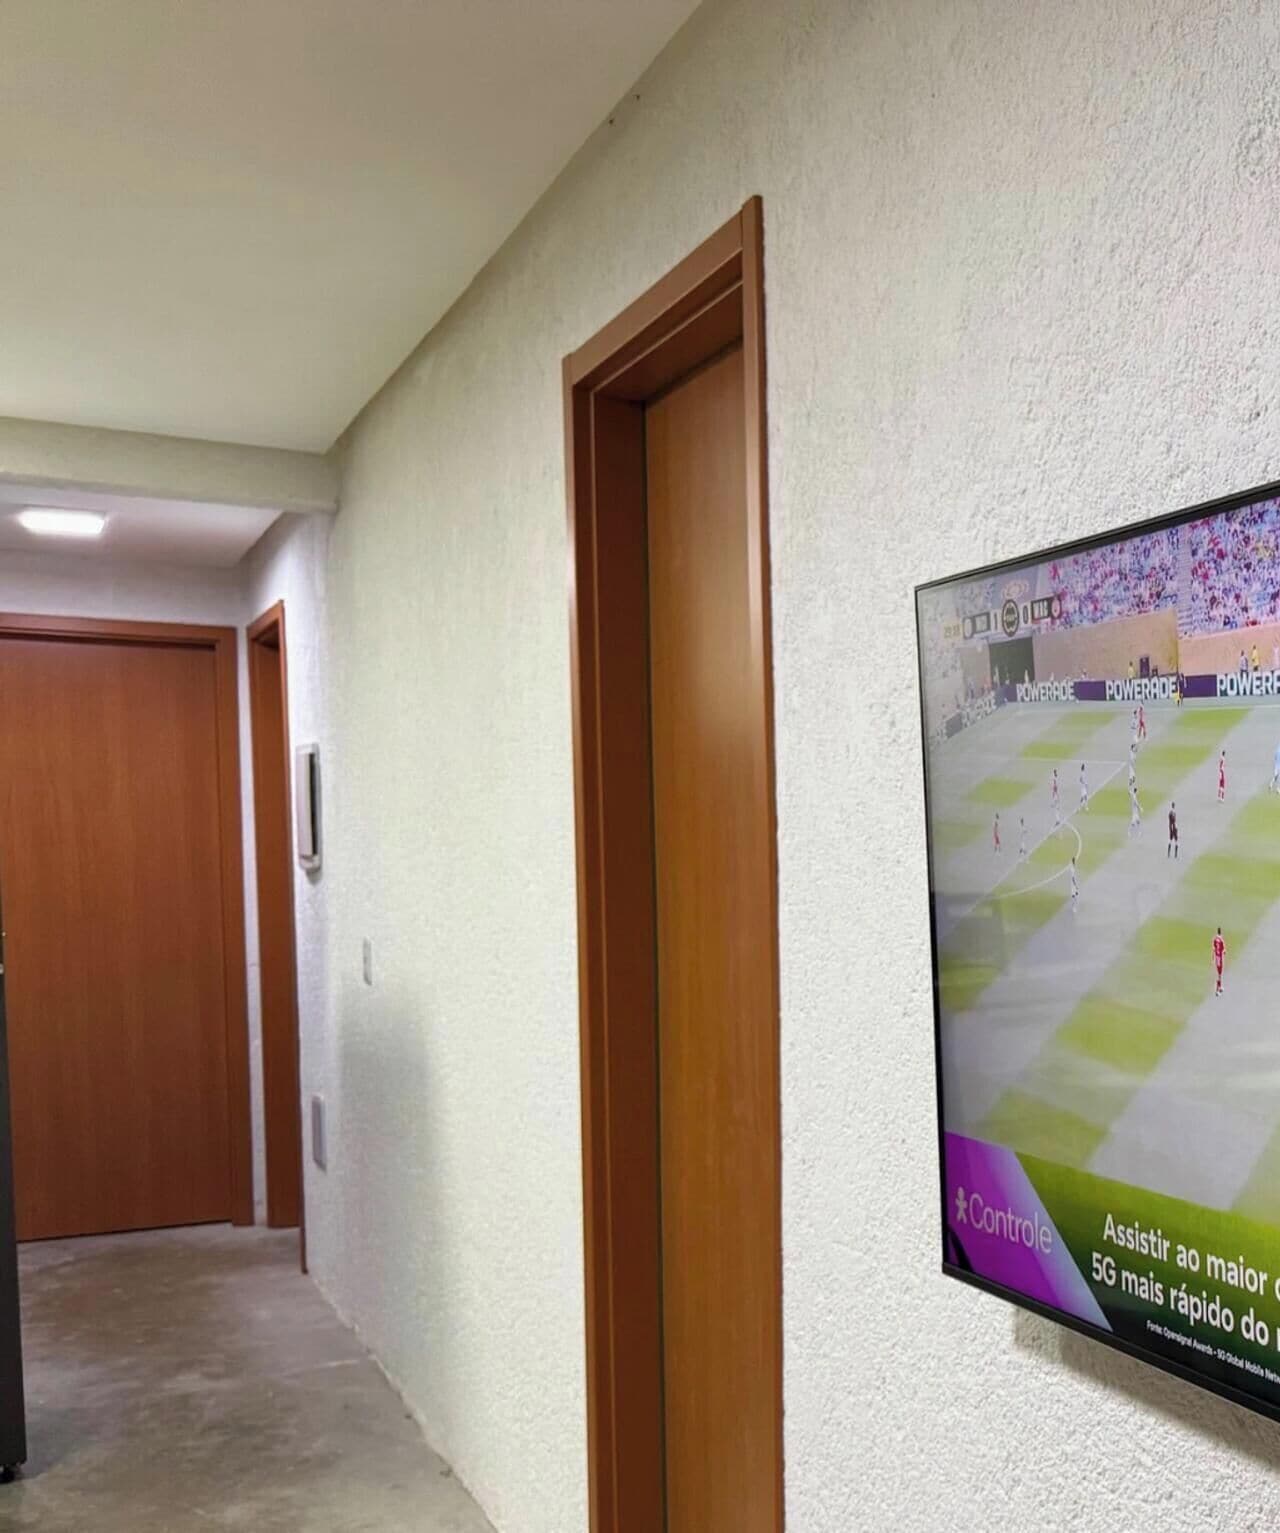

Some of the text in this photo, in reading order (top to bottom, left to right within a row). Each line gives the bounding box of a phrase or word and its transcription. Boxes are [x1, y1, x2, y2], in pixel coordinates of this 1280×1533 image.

[1016, 680, 1075, 702] POWERADE
[1106, 677, 1178, 700] POWERADE
[969, 1192, 1052, 1253] Controle
[1103, 1212, 1171, 1262] Assistir
[1176, 1243, 1200, 1273] ao
[1206, 1252, 1268, 1296] maior
[1092, 1251, 1117, 1287] 5G
[1121, 1267, 1164, 1307] mais
[1170, 1282, 1235, 1334] rápido
[1241, 1307, 1270, 1347] do
